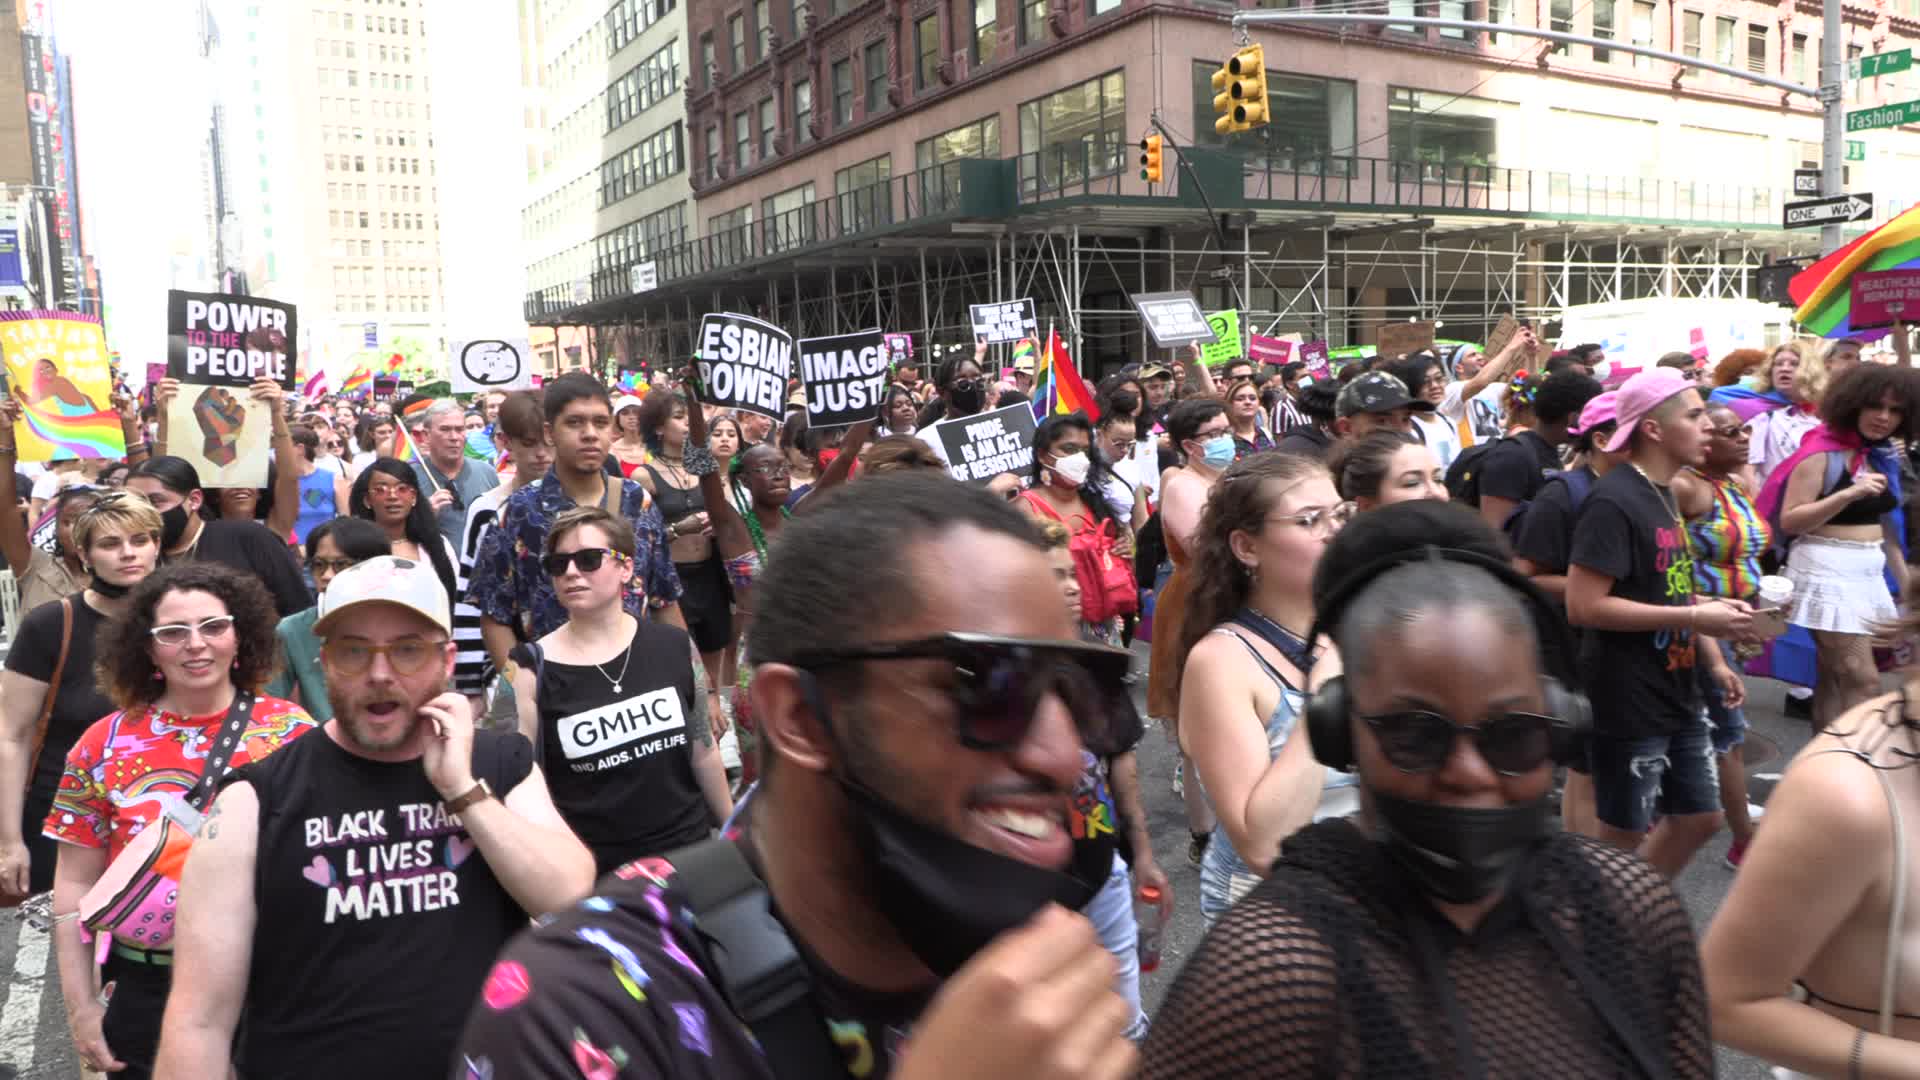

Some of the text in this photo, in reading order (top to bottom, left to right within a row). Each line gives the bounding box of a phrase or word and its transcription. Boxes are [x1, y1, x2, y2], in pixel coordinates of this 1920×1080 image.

[1872, 57, 1880, 72] 7
[1886, 55, 1897, 64] Av
[1850, 109, 1903, 129] Fashion
[1798, 177, 1815, 189] ONE
[1790, 202, 1860, 222] ONE WAY
[187, 300, 287, 338] POWER
[185, 330, 240, 348] TO THE
[703, 323, 790, 379] ESBIAN
[187, 347, 286, 380] PEOPLE
[698, 361, 783, 413] POWER
[965, 418, 1006, 442] PRIDE
[960, 432, 1022, 462] IS AN ACT
[951, 464, 969, 481] OF
[573, 698, 672, 747] GMHC
[597, 750, 633, 771] AIDS.
[634, 739, 663, 758] LIVE
[305, 809, 387, 847] BLACK
[346, 840, 433, 877] LIVES
[324, 871, 460, 924] MATTER
